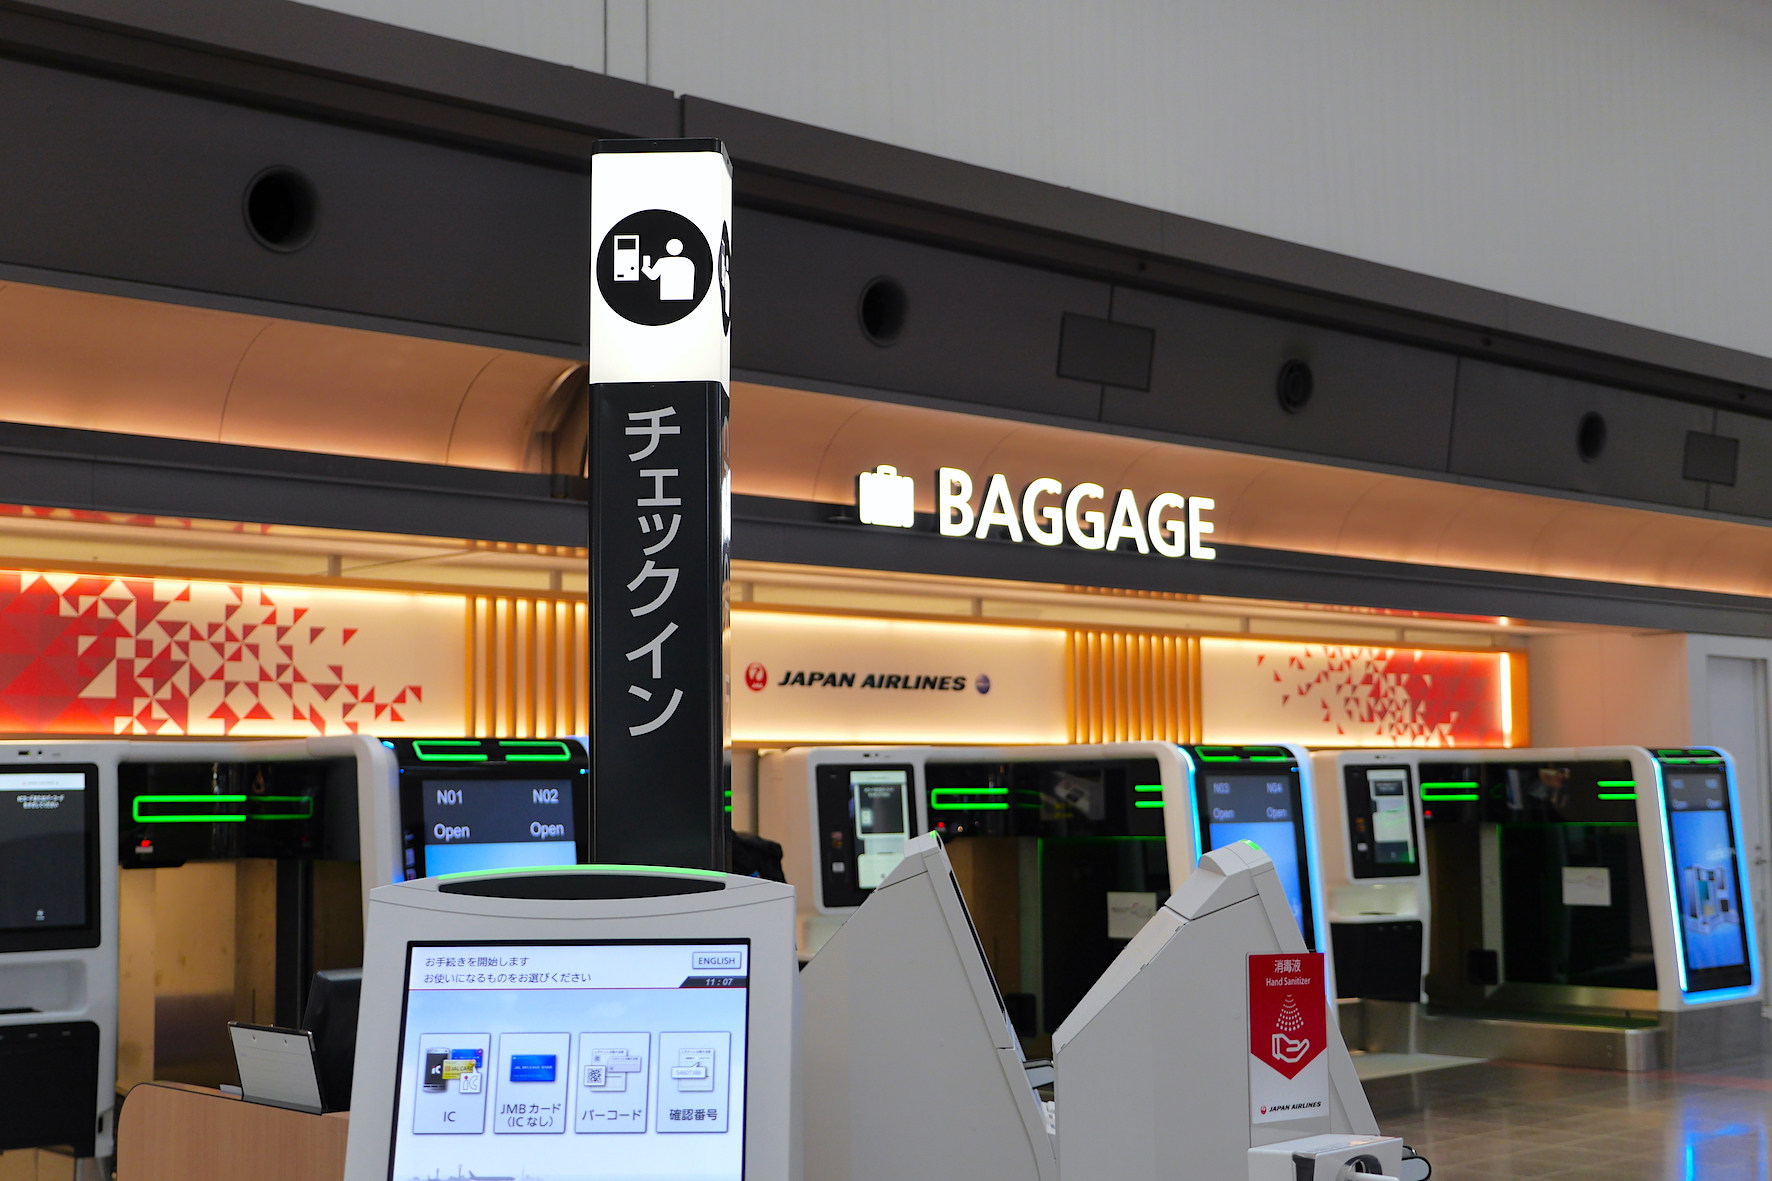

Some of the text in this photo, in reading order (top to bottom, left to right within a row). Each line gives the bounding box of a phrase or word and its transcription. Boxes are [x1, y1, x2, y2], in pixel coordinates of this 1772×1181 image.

[939, 466, 1216, 560] BAGGAGE
[625, 406, 684, 737] チェックイン
[778, 671, 967, 691] JAPAN AIRLINES
[437, 789, 463, 805] N01
[533, 788, 559, 804] N02
[1213, 807, 1234, 820] Open
[1266, 806, 1287, 819] Open
[433, 823, 470, 842] Open
[530, 821, 565, 839] Open
[425, 957, 529, 967] お手続きを開始します
[698, 957, 736, 965] ENGLISH
[1274, 959, 1301, 973] 消毒液
[424, 973, 592, 984] お使いになるものをお選びください
[1265, 976, 1311, 987] Hand Sanitizer
[1291, 1101, 1321, 1110] AIRLINES
[443, 1111, 456, 1122] IC
[582, 1109, 642, 1120] バーコード
[669, 1109, 718, 1121] 確認番号
